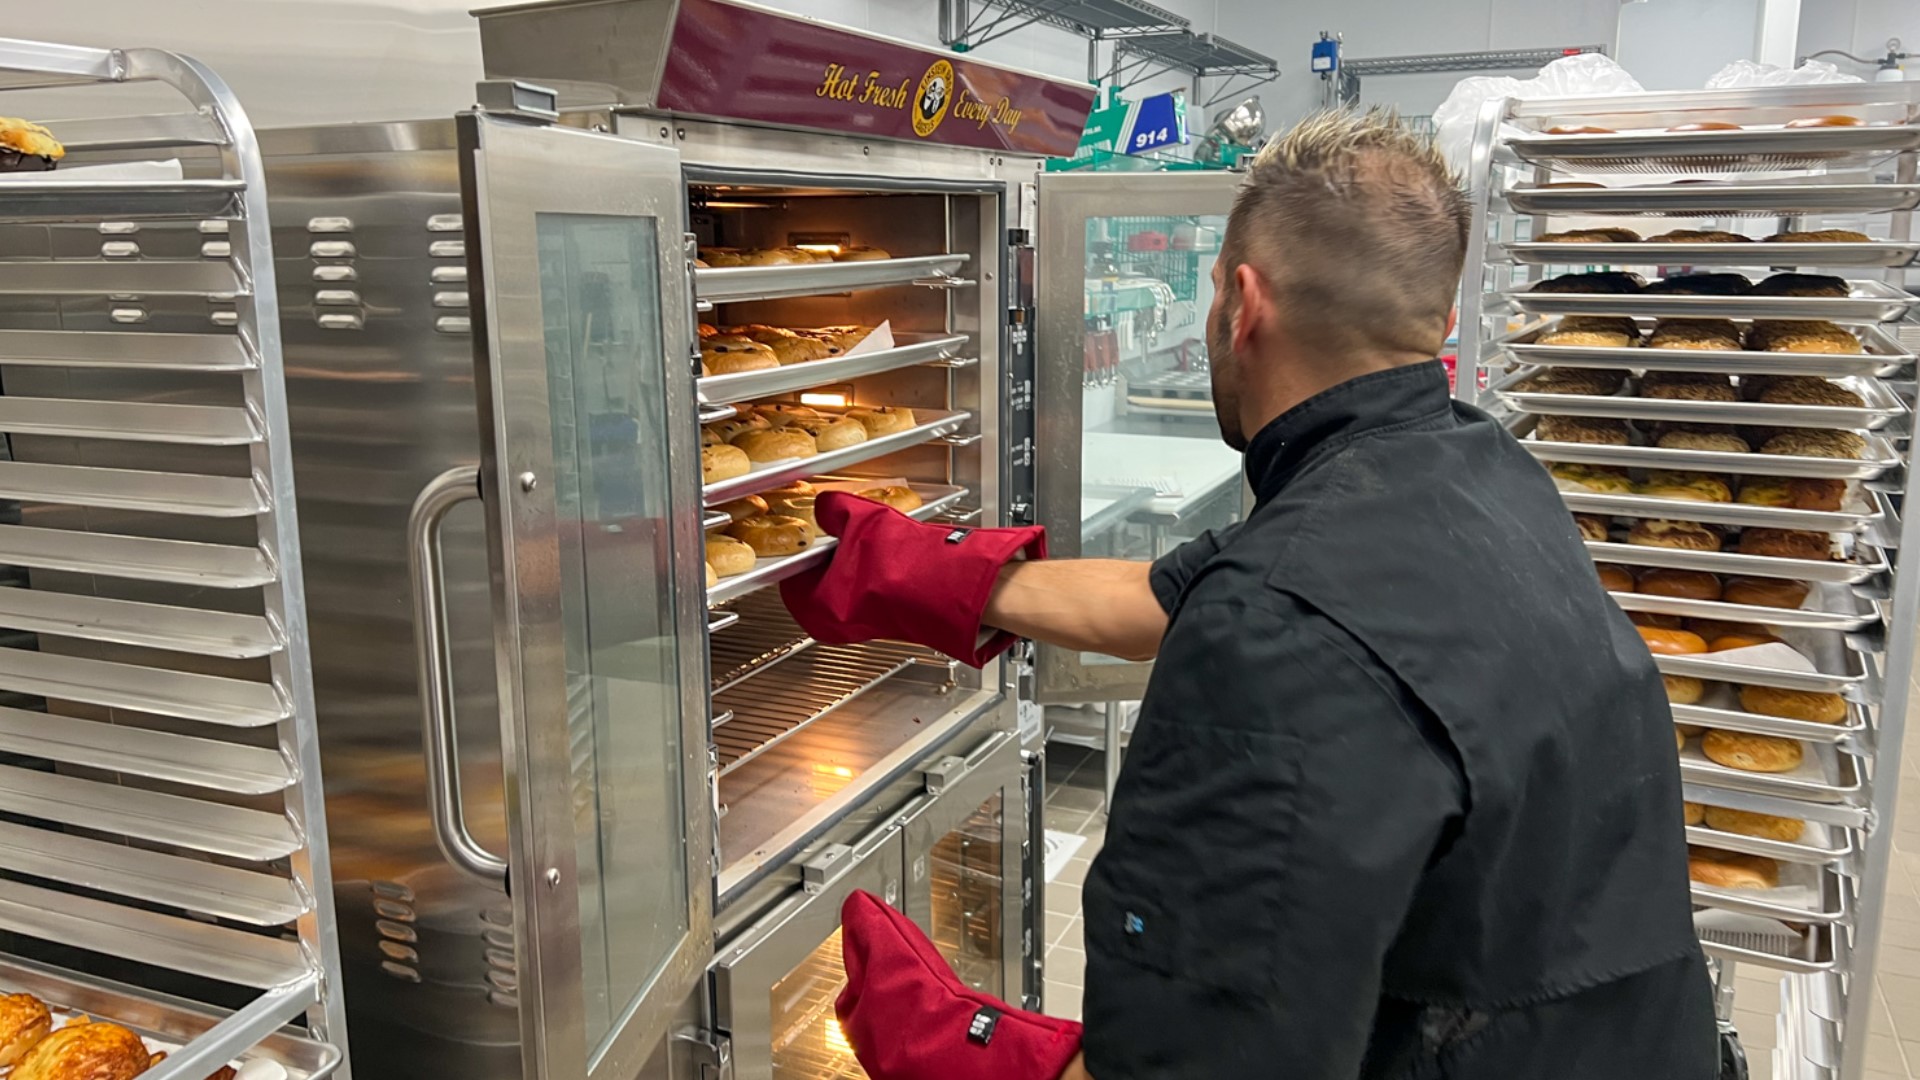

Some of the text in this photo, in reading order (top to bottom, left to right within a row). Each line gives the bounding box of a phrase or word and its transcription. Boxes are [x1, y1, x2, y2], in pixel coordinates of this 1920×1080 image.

[816, 63, 859, 101] Hot
[859, 70, 910, 109] Fresh
[954, 89, 1021, 134] Every Day
[1136, 127, 1168, 148] 914
